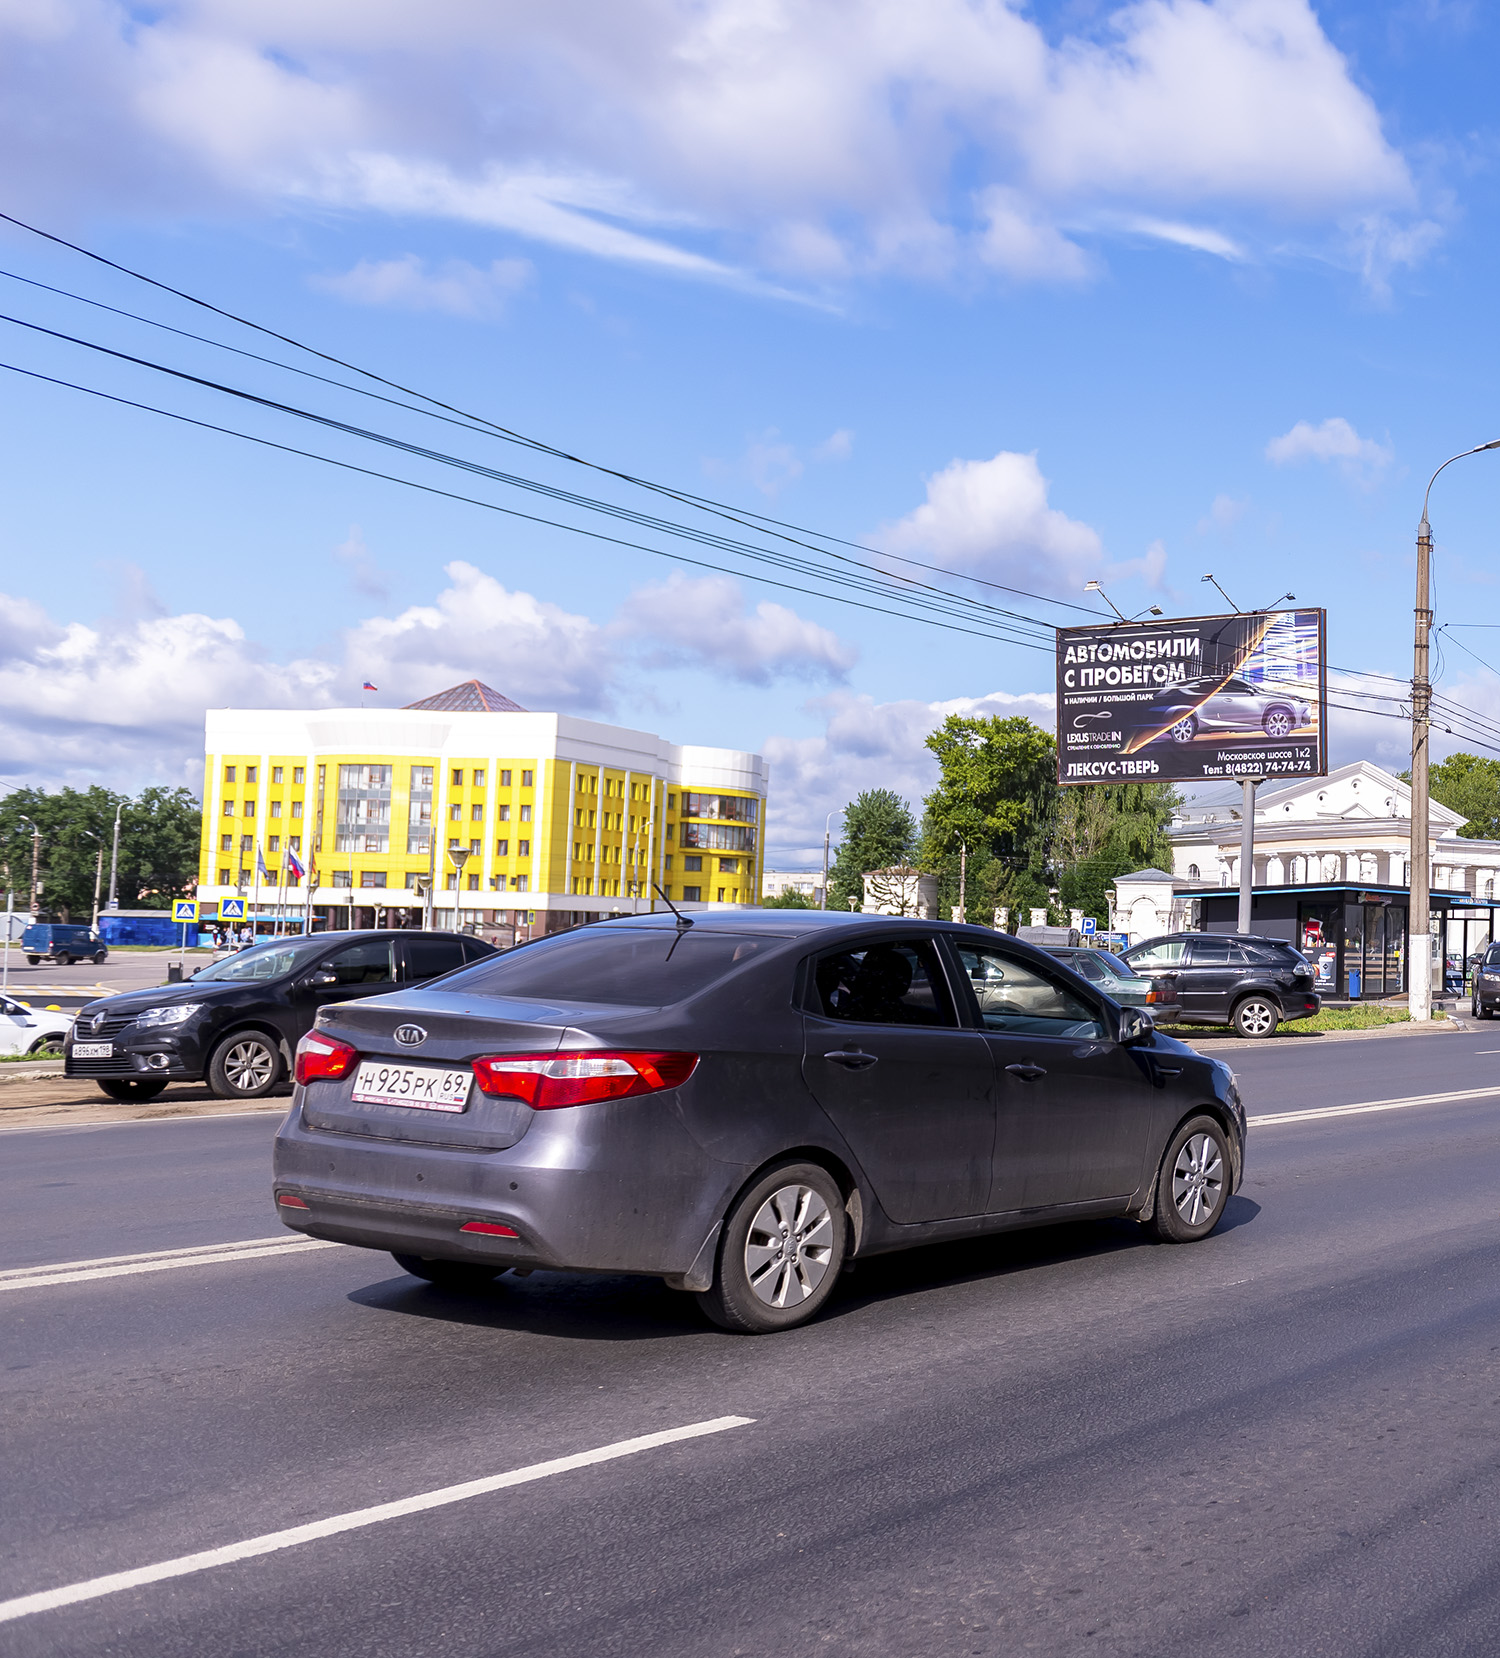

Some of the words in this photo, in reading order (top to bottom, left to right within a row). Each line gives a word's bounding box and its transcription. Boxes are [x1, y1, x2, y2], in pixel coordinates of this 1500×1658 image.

[1064, 638, 1200, 664] АВТОМОБИЛИ
[1064, 669, 1075, 688] С
[1080, 662, 1186, 687] ПРОБЕГОМ
[1069, 695, 1098, 704] НАЛИЧИИ
[1103, 692, 1136, 702] БОЛЬШОЙ
[1217, 751, 1266, 761] Московское
[1267, 750, 1292, 759] шоссе
[1295, 747, 1311, 758] 1к2
[1066, 760, 1160, 777] ЛЕКСУС-ТВЕРЬ
[1203, 765, 1223, 775] Тел:
[1225, 762, 1263, 776] 8(4822)
[1265, 760, 1311, 773] 74-74-74
[398, 1028, 420, 1042] KIA
[361, 1068, 438, 1098] Н925РК
[442, 1073, 464, 1093] 69
[440, 1092, 454, 1101] RUS
